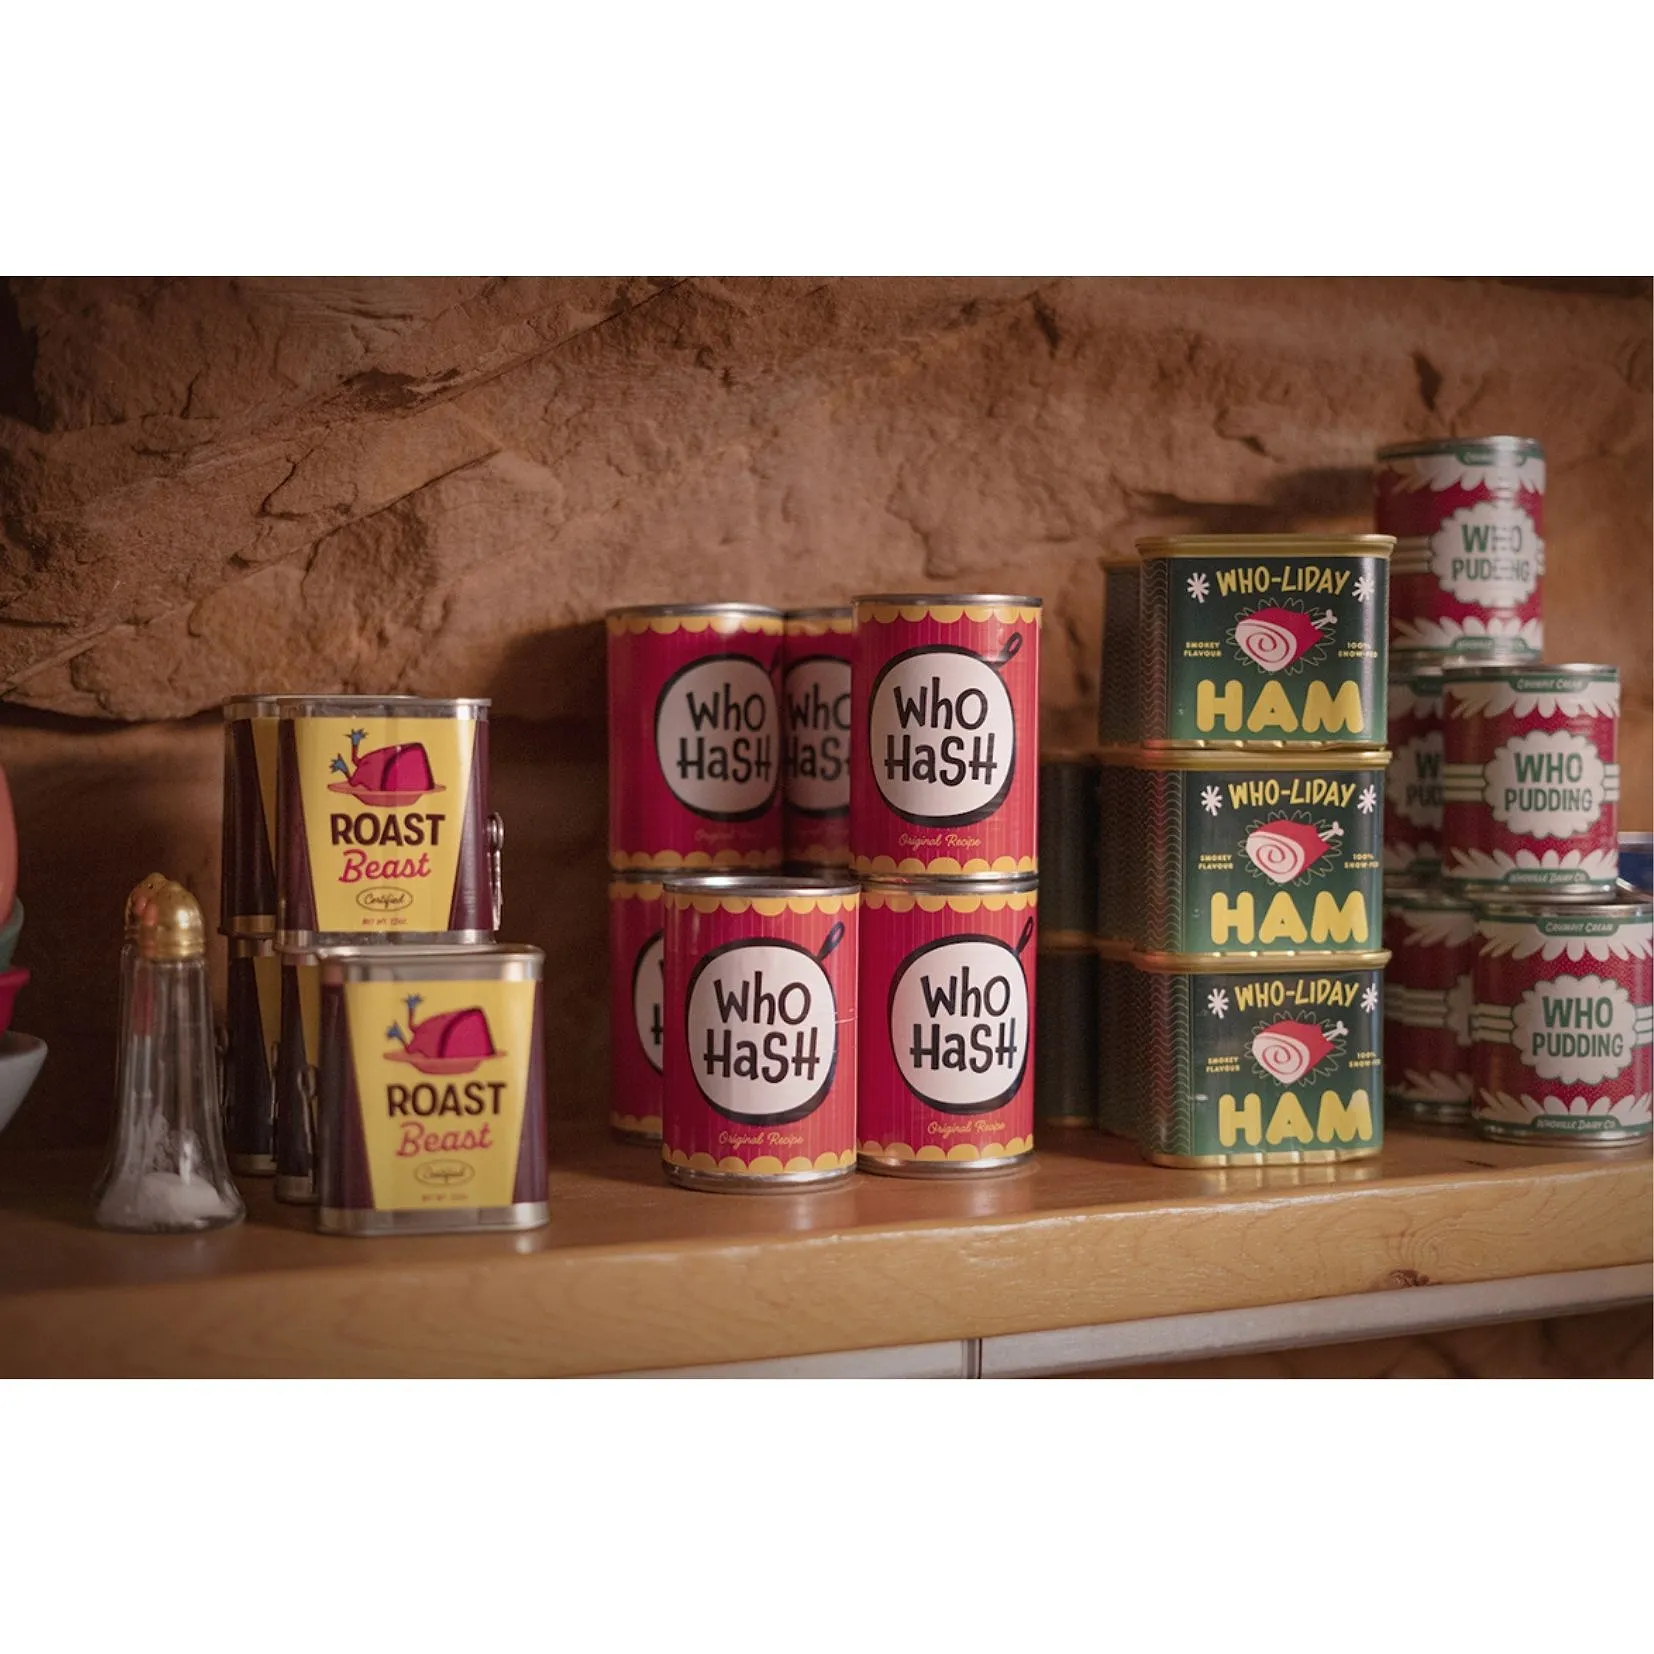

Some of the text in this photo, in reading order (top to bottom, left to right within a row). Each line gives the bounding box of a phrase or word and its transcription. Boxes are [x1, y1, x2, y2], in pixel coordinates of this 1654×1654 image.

[1216, 565, 1351, 597] WHO-LIDAY
[1185, 641, 1220, 649] SMOKEY
[1197, 679, 1365, 733] HAM
[1514, 752, 1583, 784] WHO
[1228, 778, 1356, 809] WHO-LIDAY
[1504, 788, 1593, 812] PUDDING
[330, 812, 446, 847] ROAST
[899, 832, 982, 852] Original Recipe
[338, 848, 432, 884] Beast
[1198, 862, 1234, 870] FLAVOUR
[1211, 891, 1369, 945] HAM
[1234, 979, 1359, 1011] WHO-LIDAY
[1542, 996, 1614, 1029] WHO
[1532, 1032, 1624, 1058] PUDDING
[386, 1081, 508, 1119] ROAST
[927, 1120, 972, 1137] Original
[1218, 1089, 1373, 1147] HAM
[395, 1121, 494, 1157] Beast
[718, 1130, 804, 1151] Original Recipe
